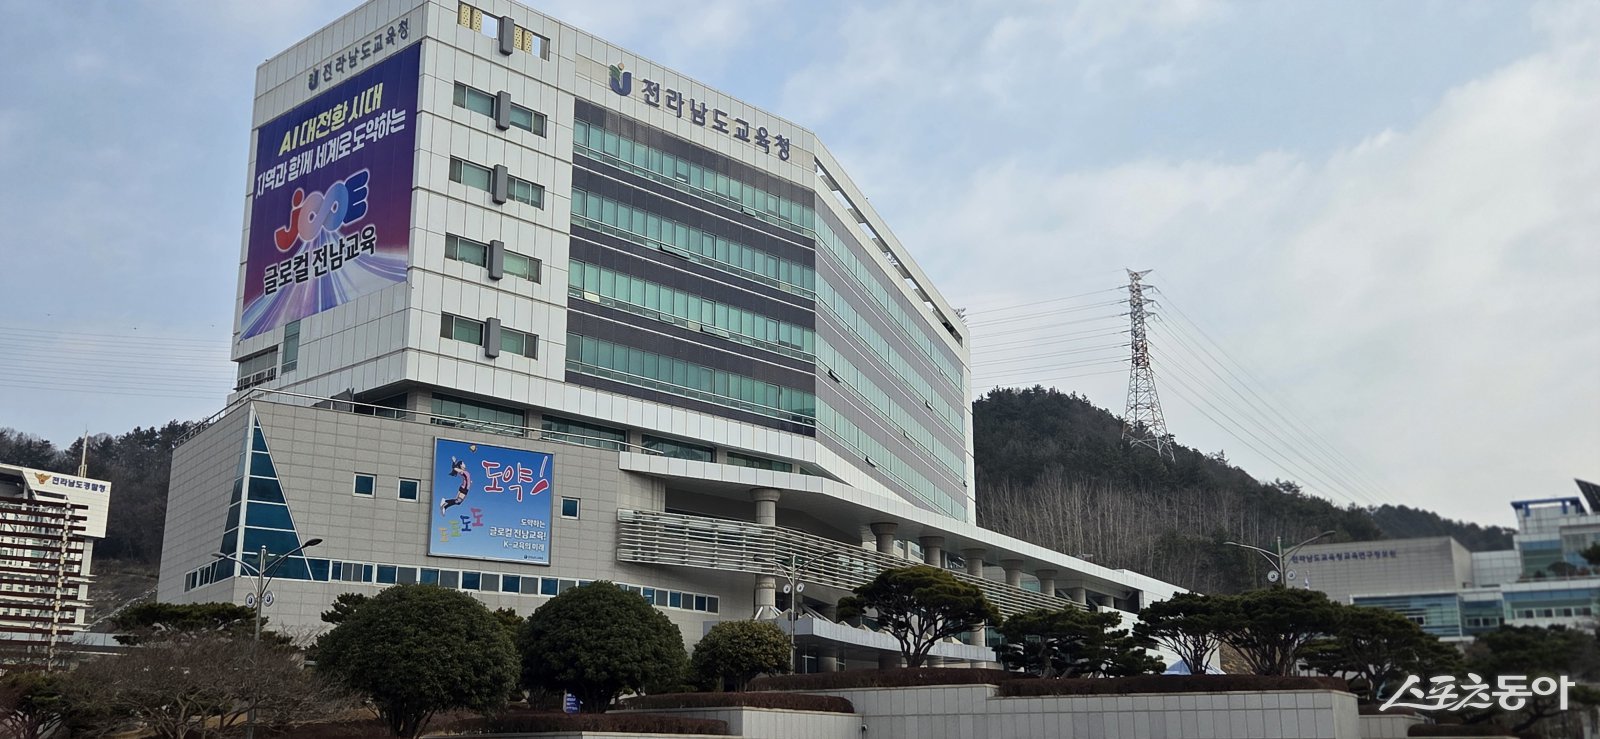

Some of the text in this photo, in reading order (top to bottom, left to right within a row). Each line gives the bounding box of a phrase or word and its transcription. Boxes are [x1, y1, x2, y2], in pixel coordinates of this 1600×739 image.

[323, 18, 409, 82] 전라남도교육청
[278, 82, 384, 157] AI 대전환 시대
[641, 79, 790, 161] 전라남도교육청
[255, 108, 406, 199] 지역과 함께 세계로 도약하는
[263, 225, 377, 296] 글로컬 전남교육
[52, 476, 106, 492] 전라남도경찰청
[481, 455, 550, 502] 도약!
[489, 527, 547, 541] 글로컬 전남교육!
[520, 518, 546, 529] 도약하는
